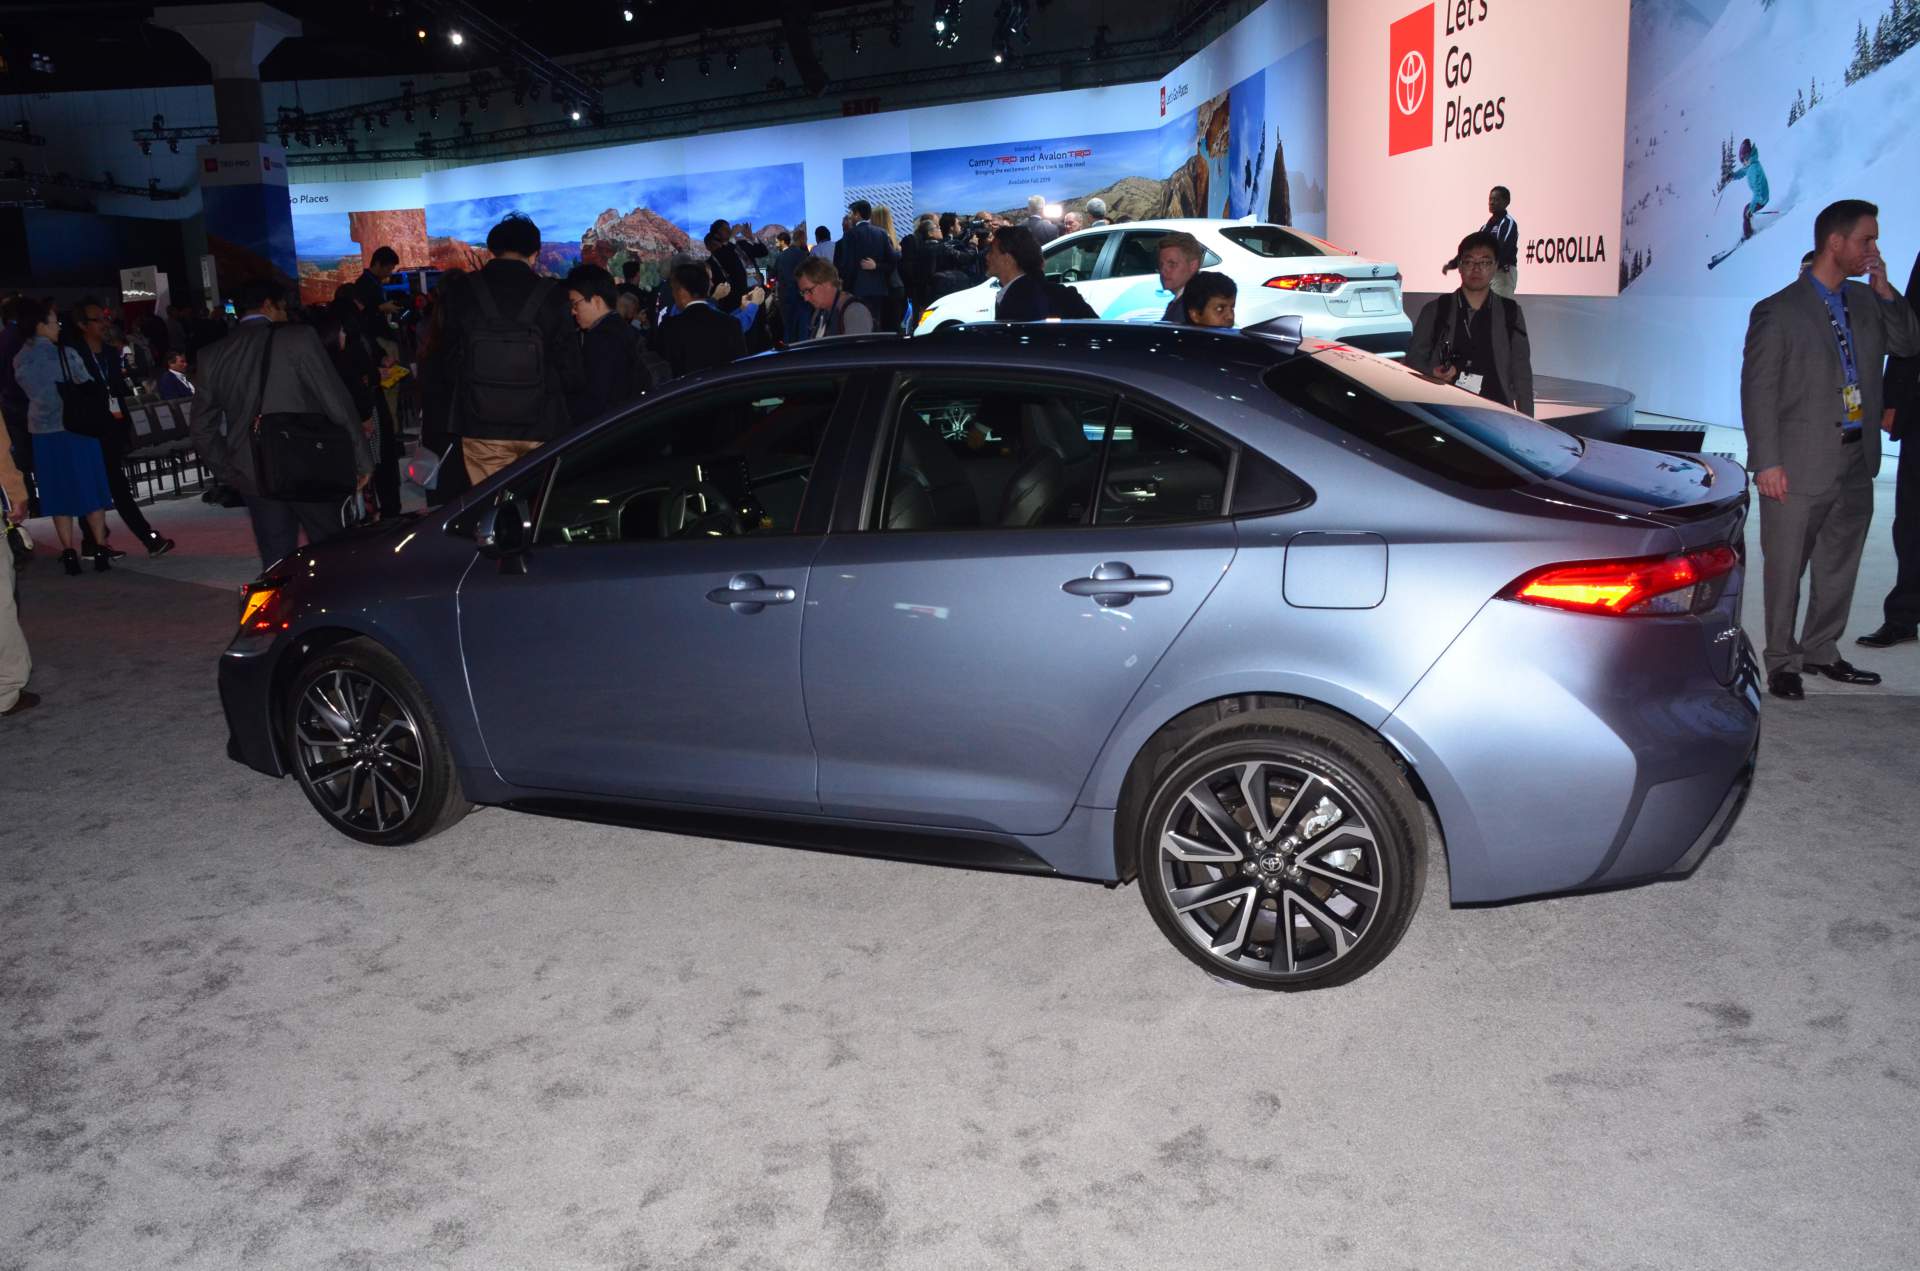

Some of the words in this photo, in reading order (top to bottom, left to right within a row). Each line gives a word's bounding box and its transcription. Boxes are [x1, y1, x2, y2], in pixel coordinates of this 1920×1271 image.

[1446, 0, 1487, 36] Lets
[1445, 45, 1472, 88] Go
[1444, 95, 1506, 143] Places
[969, 158, 993, 167] Camry
[1019, 154, 1036, 163] and
[1039, 151, 1067, 161] Avalon
[1067, 149, 1092, 159] TRD
[300, 194, 329, 204] Places
[1526, 235, 1606, 264] #COROLLA
